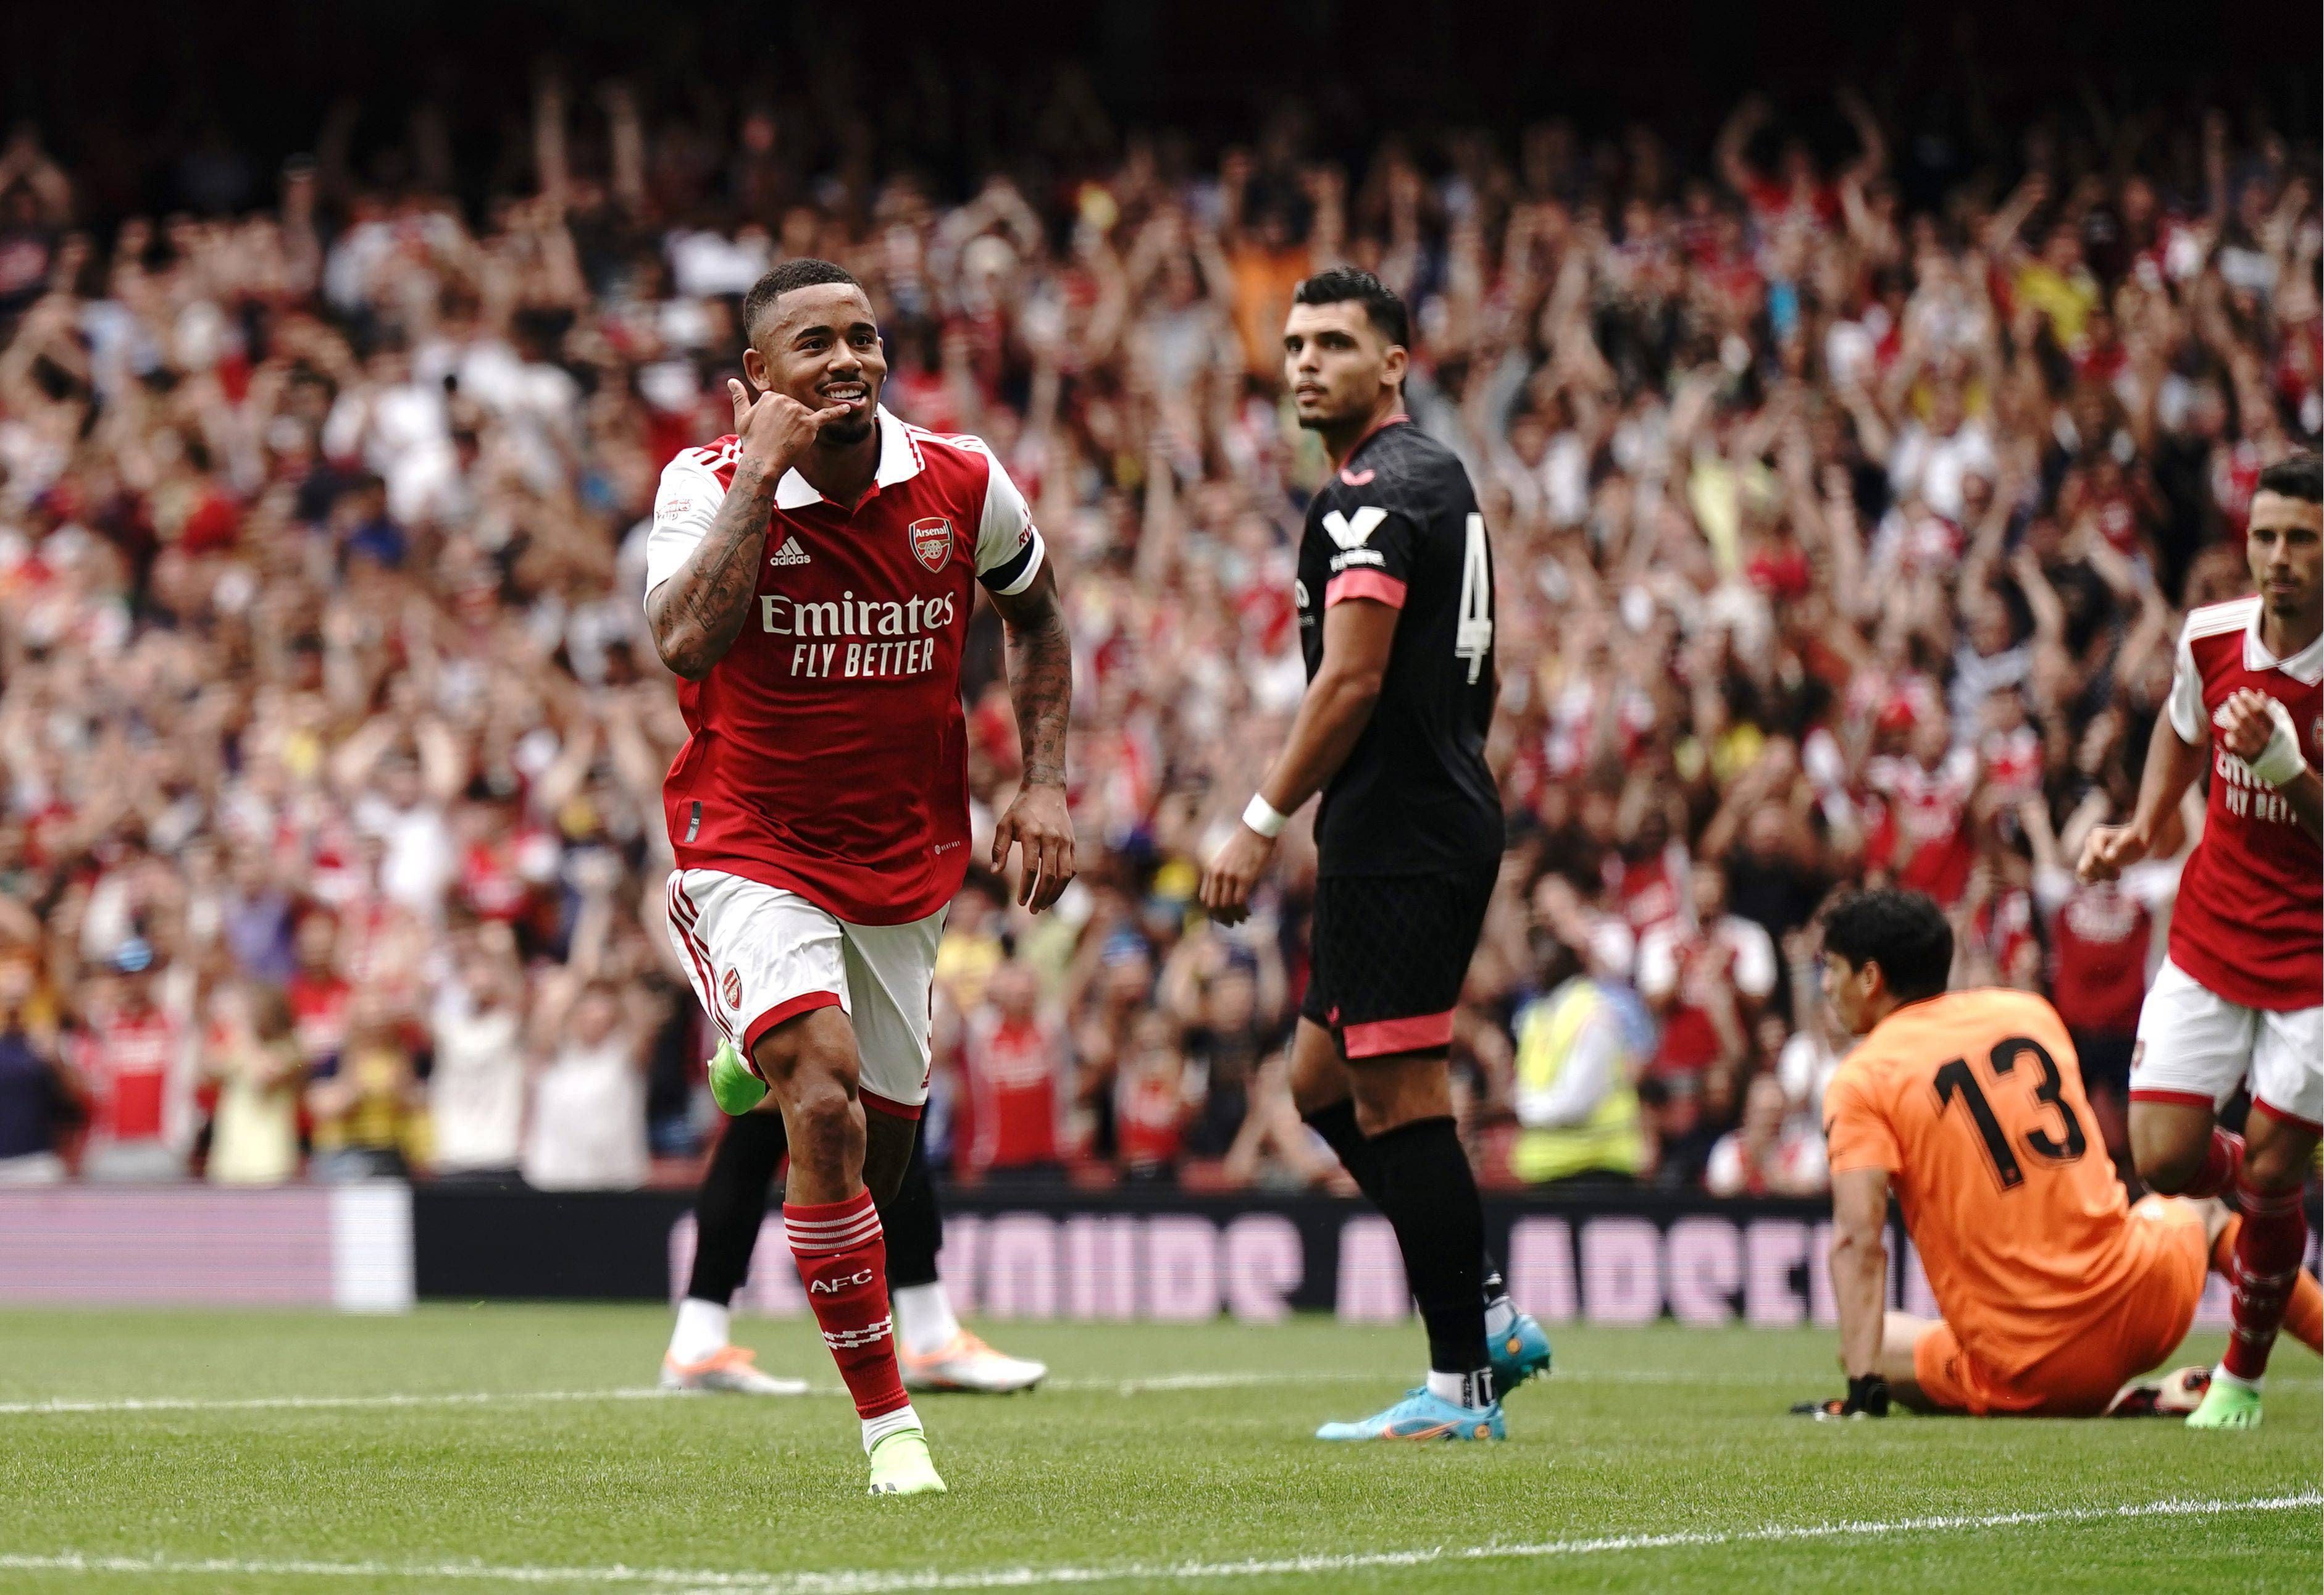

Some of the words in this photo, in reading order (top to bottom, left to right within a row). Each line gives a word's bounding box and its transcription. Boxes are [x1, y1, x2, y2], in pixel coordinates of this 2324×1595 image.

[915, 525, 947, 538] Arsenal
[770, 553, 811, 566] adidas
[759, 590, 953, 637] Emirates
[1455, 512, 1492, 685] 4
[790, 643, 836, 677] FLY
[844, 637, 934, 678] BETTER
[1933, 1037, 2087, 1192] 13
[810, 1268, 873, 1294] AFC
